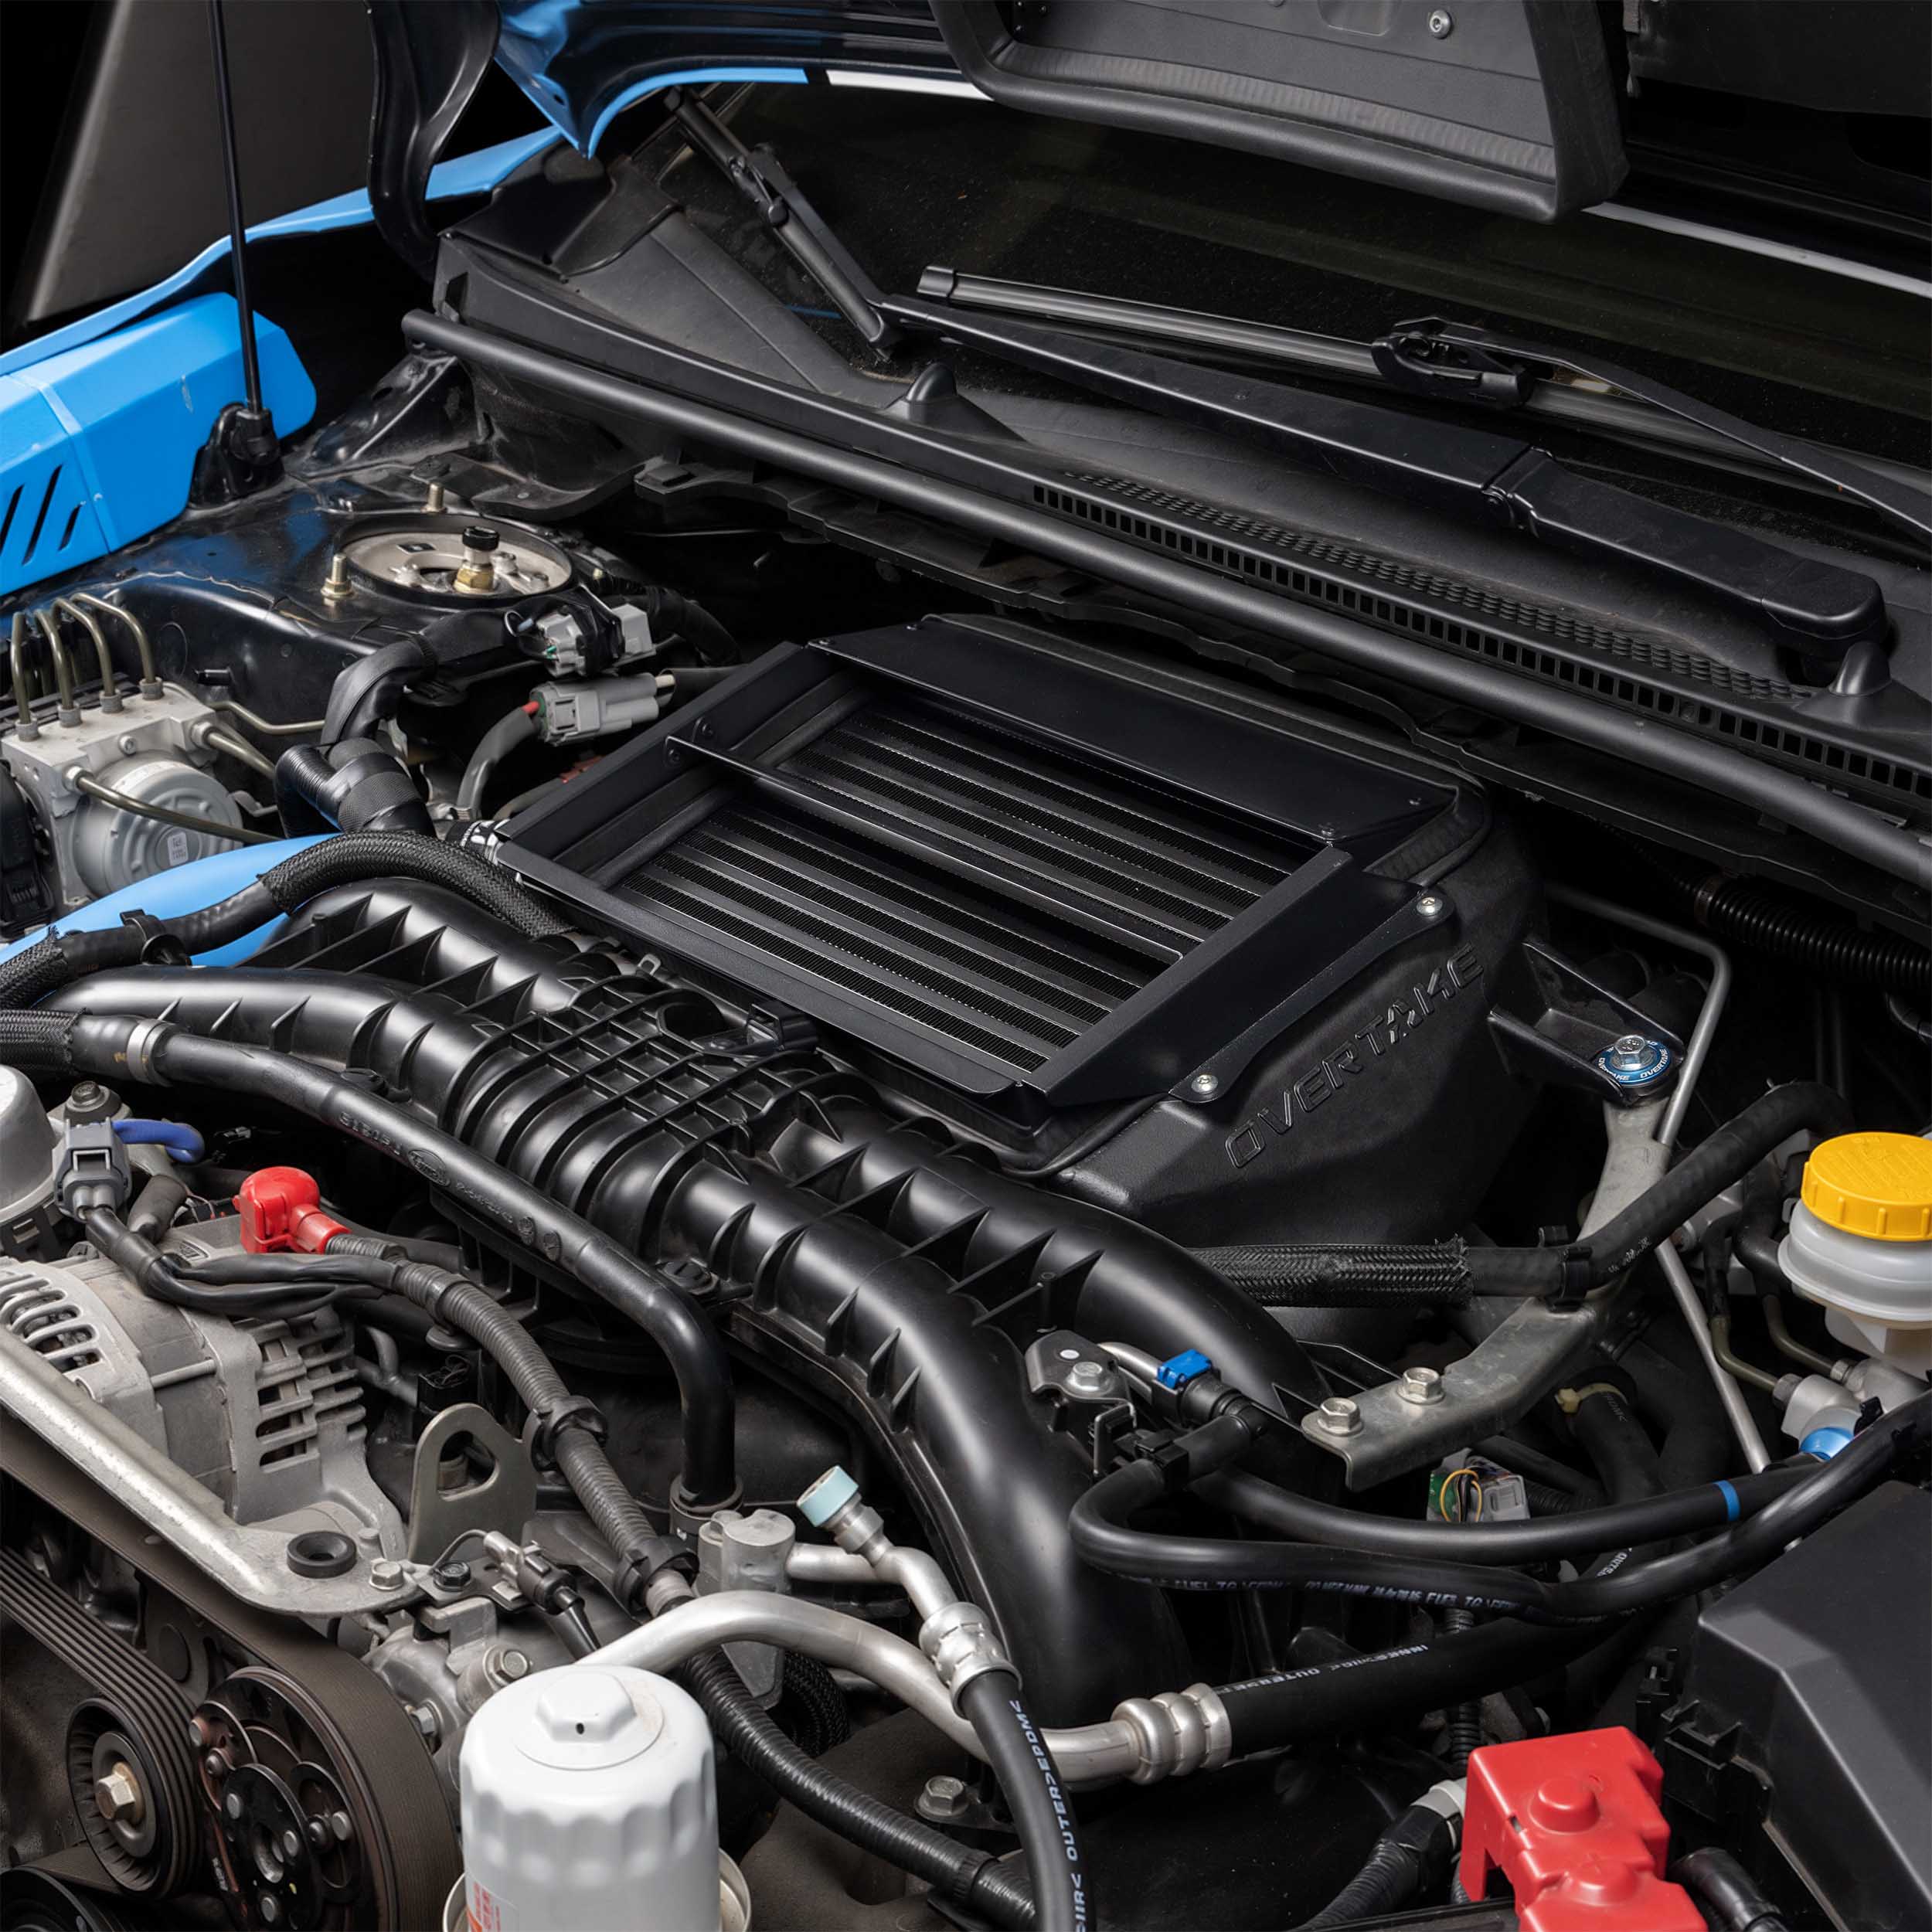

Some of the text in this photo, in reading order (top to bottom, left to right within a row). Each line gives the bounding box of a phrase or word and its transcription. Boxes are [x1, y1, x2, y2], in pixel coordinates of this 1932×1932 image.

[1225, 943, 1485, 1168] OVERTAKE
[1598, 1057, 1631, 1081] OVEAKE
[1640, 1048, 1669, 1079] OVERTAKE
